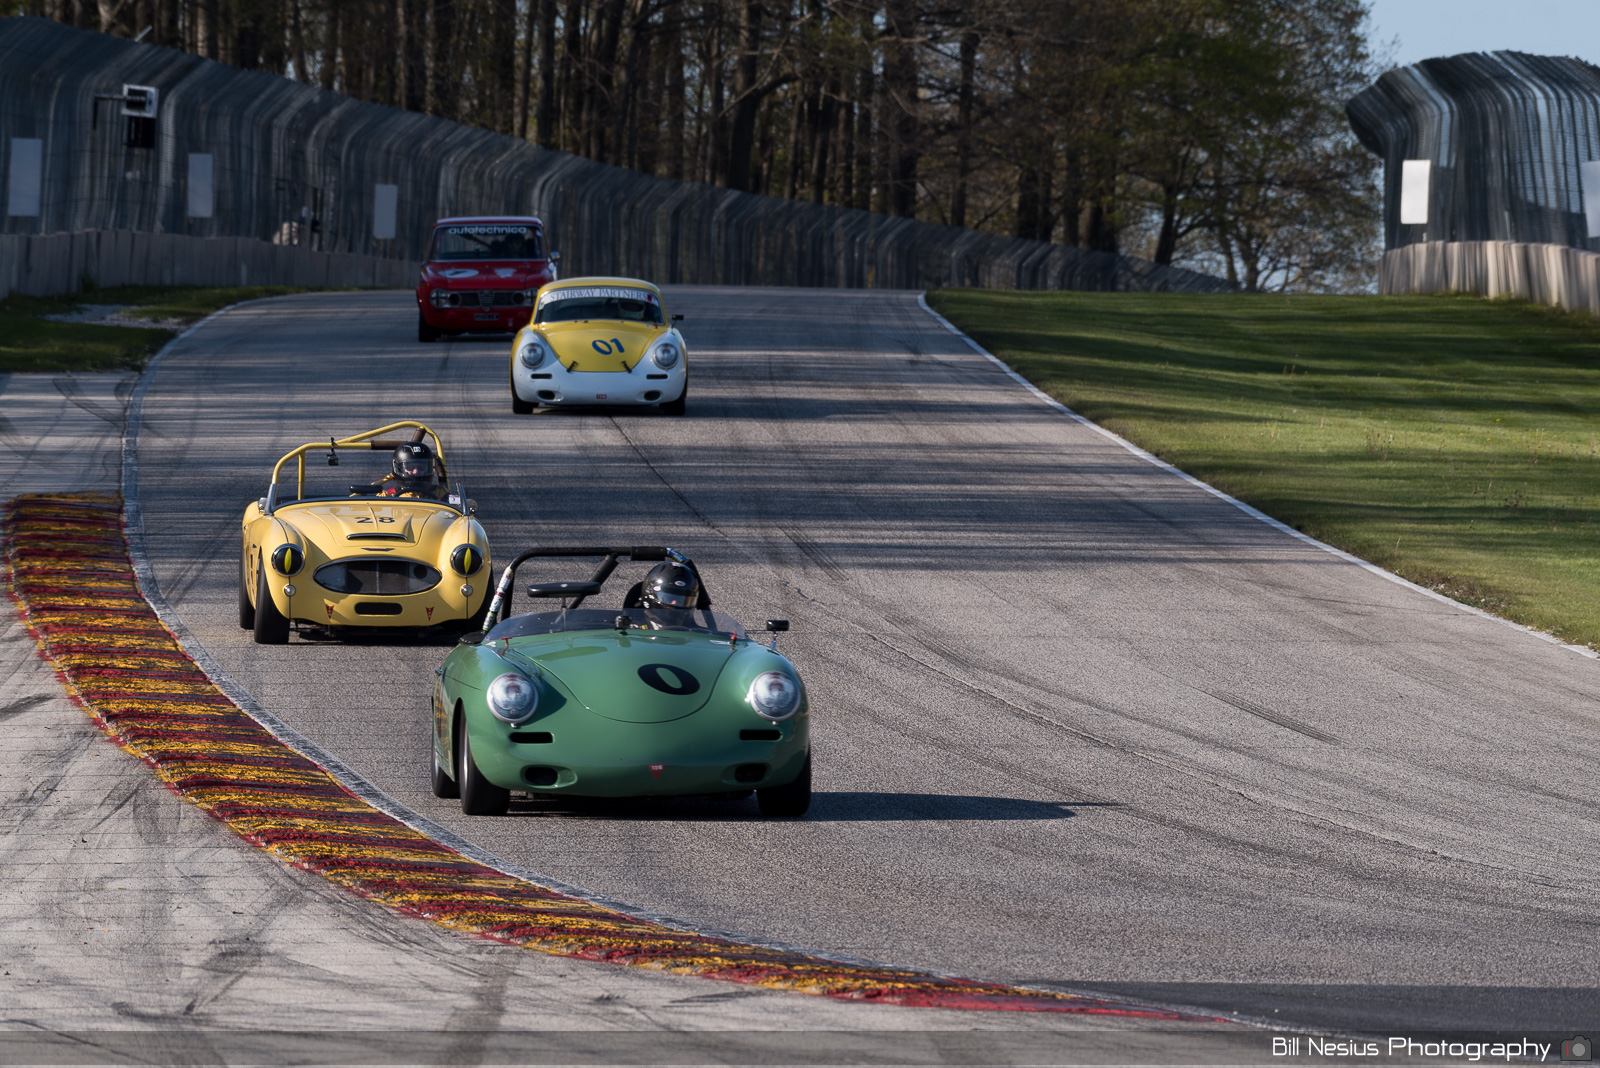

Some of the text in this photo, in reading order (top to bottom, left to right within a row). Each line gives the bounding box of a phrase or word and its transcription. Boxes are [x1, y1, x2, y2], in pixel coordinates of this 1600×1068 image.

[448, 225, 527, 235] autotechnica
[550, 288, 647, 301] STAIRWAY PARTNERS
[591, 338, 625, 355] 01
[354, 516, 396, 524] 28
[637, 663, 700, 695] 0
